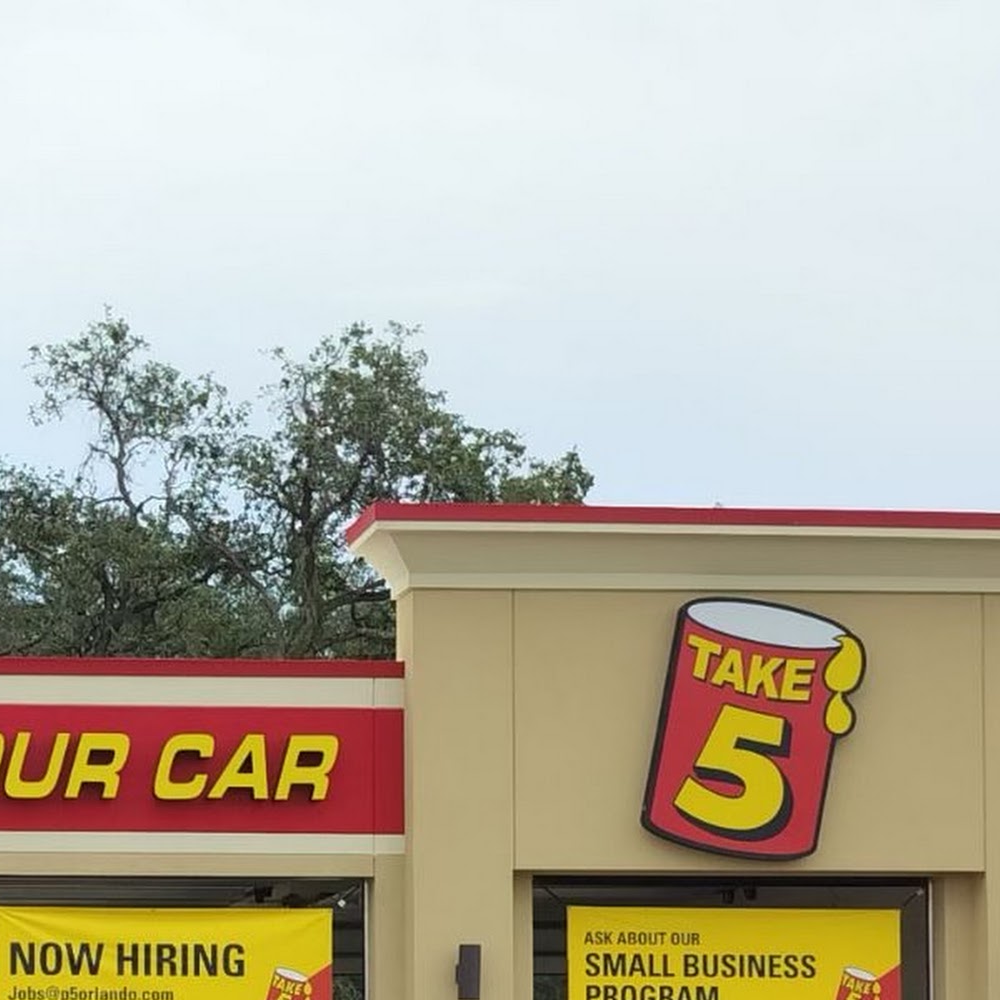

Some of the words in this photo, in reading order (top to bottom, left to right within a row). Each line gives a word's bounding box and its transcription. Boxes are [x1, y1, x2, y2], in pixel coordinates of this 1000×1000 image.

[686, 633, 817, 703] TAKE
[153, 733, 340, 801] CAR
[673, 703, 794, 842] 5
[584, 931, 613, 945] ASK
[617, 932, 667, 946] ABOUT
[671, 932, 700, 946] OUR
[9, 942, 104, 976] NOW
[116, 943, 245, 978] HIRING
[585, 952, 675, 978] SMALL
[682, 953, 817, 979] BUSINESS
[272, 974, 304, 996] TAKE
[842, 974, 872, 995] TAKE
